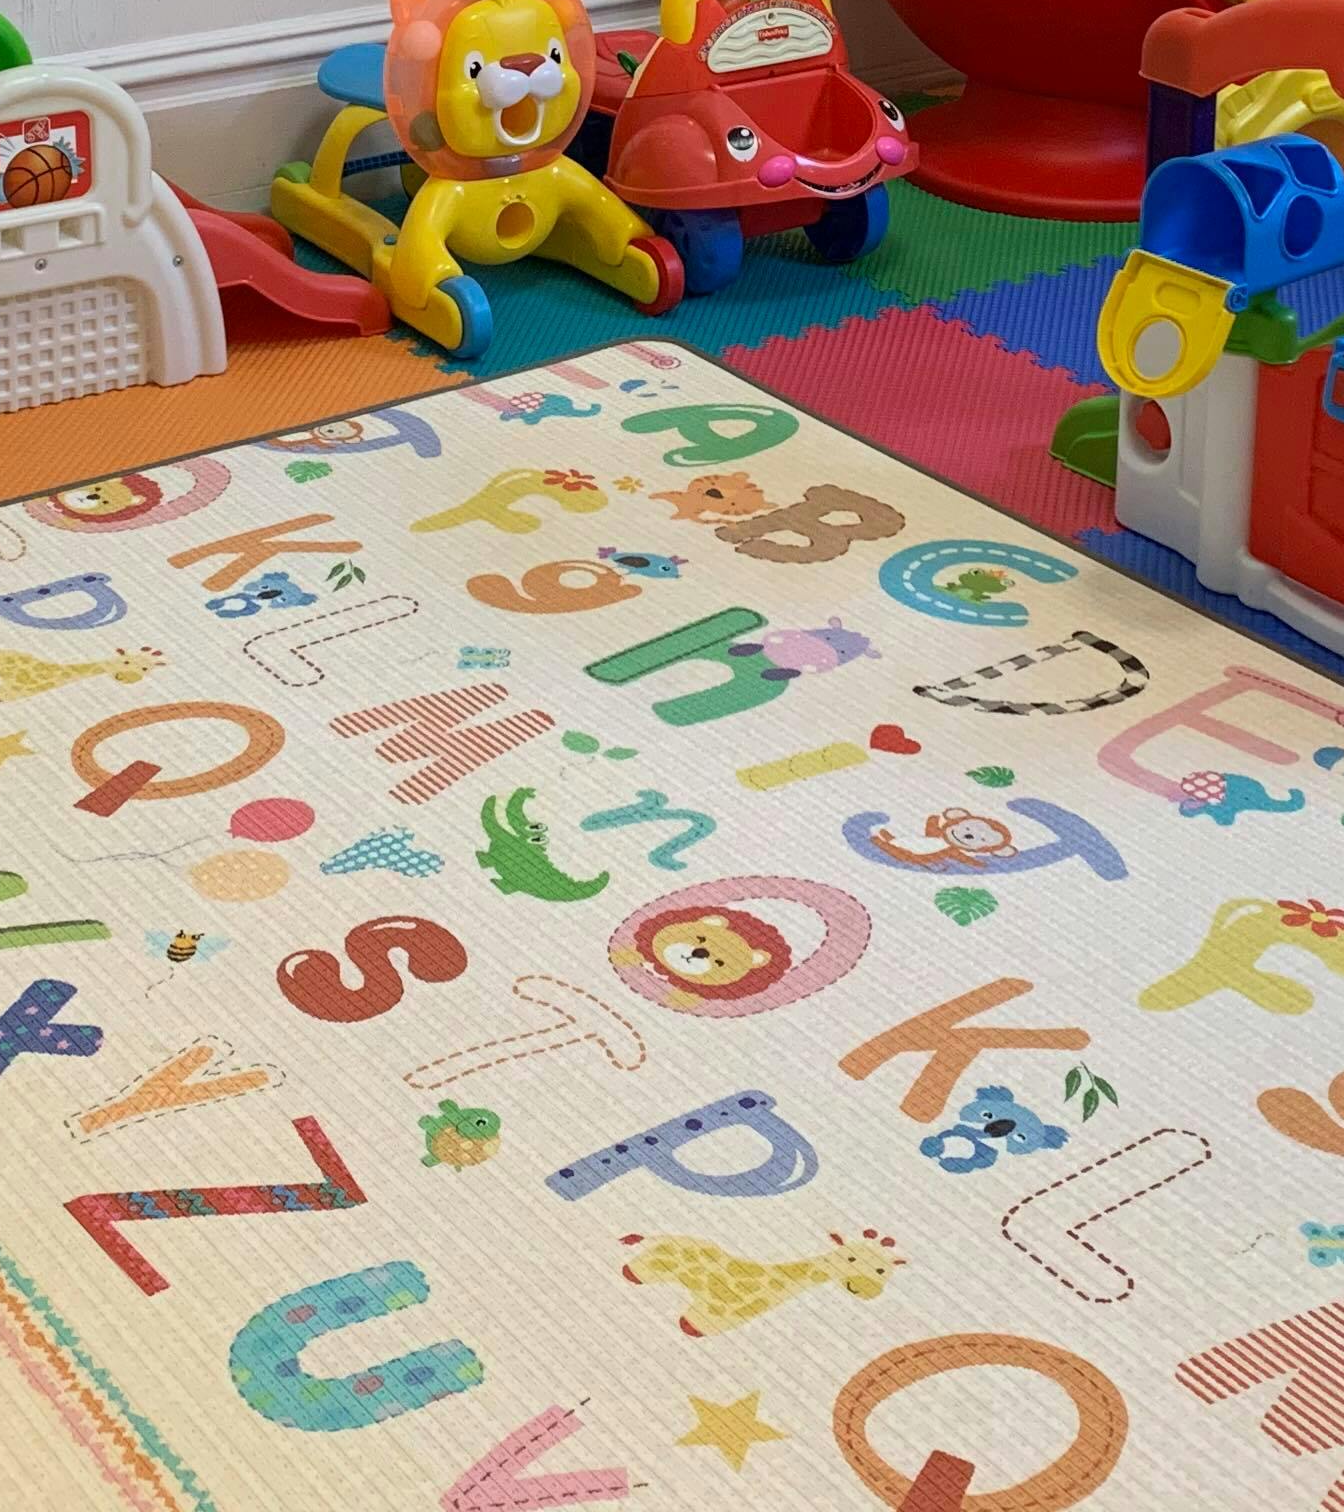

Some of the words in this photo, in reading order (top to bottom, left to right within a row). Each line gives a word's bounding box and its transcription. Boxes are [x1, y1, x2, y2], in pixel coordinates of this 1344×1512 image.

[621, 404, 800, 468] A
[168, 512, 363, 589] K
[714, 482, 906, 565] B
[878, 539, 1080, 626] C
[912, 630, 1151, 715] D
[69, 700, 287, 815] Q
[330, 683, 556, 805] M
[276, 915, 468, 1025] S
[607, 876, 872, 1018] O
[64, 1034, 288, 1143] Y
[403, 974, 648, 1091] T
[838, 977, 1092, 1123] K
[543, 1088, 819, 1201] P
[63, 1114, 367, 1296] Z
[1001, 1126, 1211, 1306] L
[228, 1260, 485, 1432] U
[833, 1332, 1130, 1512] Q
